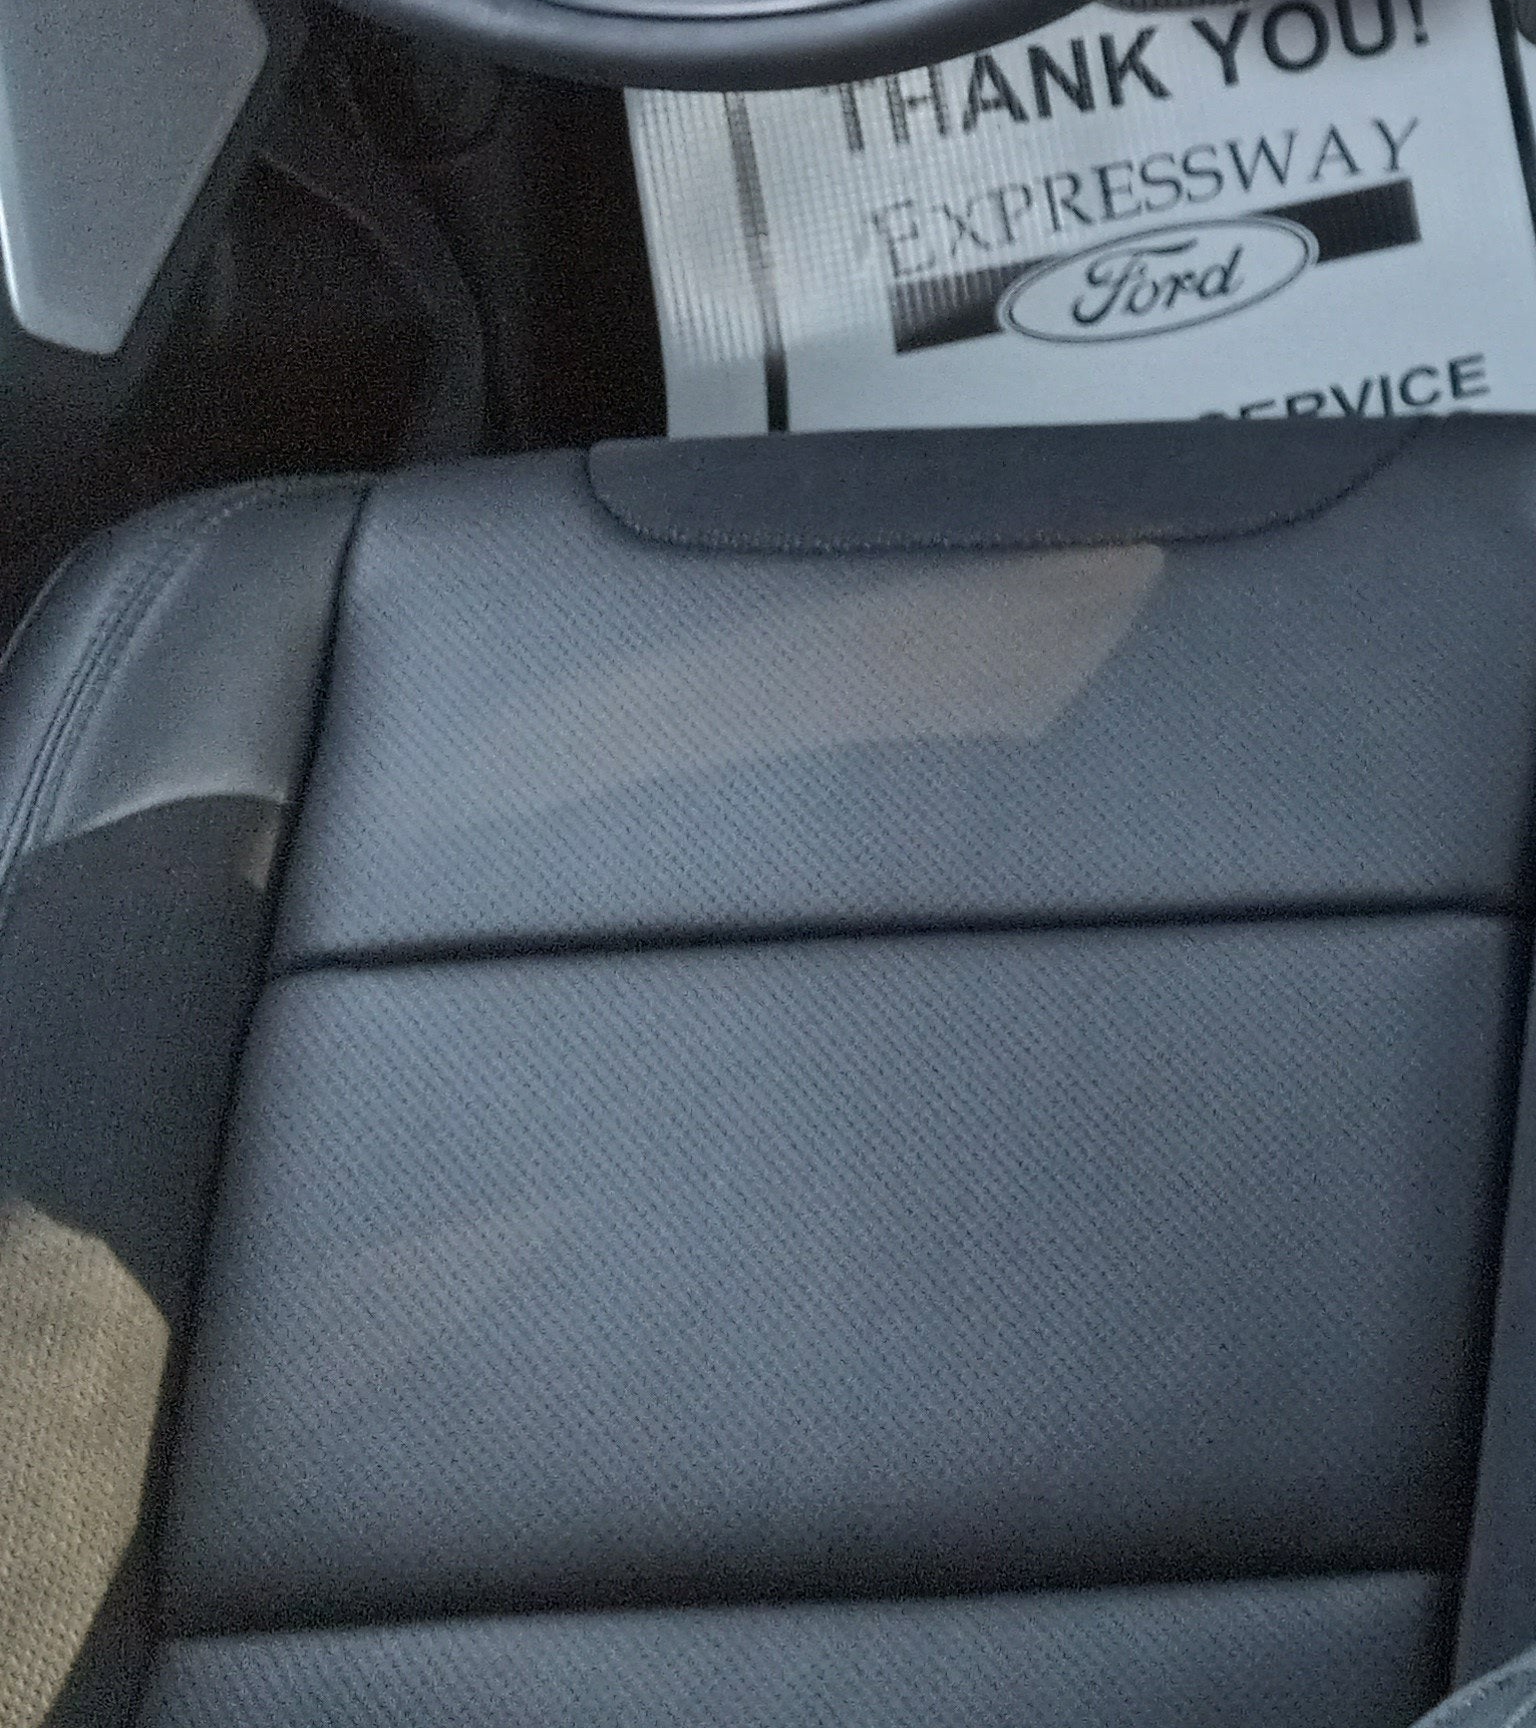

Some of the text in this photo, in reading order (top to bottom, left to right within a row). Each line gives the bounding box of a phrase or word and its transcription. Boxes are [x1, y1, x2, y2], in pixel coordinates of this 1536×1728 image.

[820, 26, 1172, 153] THANK
[870, 117, 1419, 278] EXPRESSWAY
[1071, 238, 1245, 327] Ford
[1203, 352, 1490, 419] RVICE
